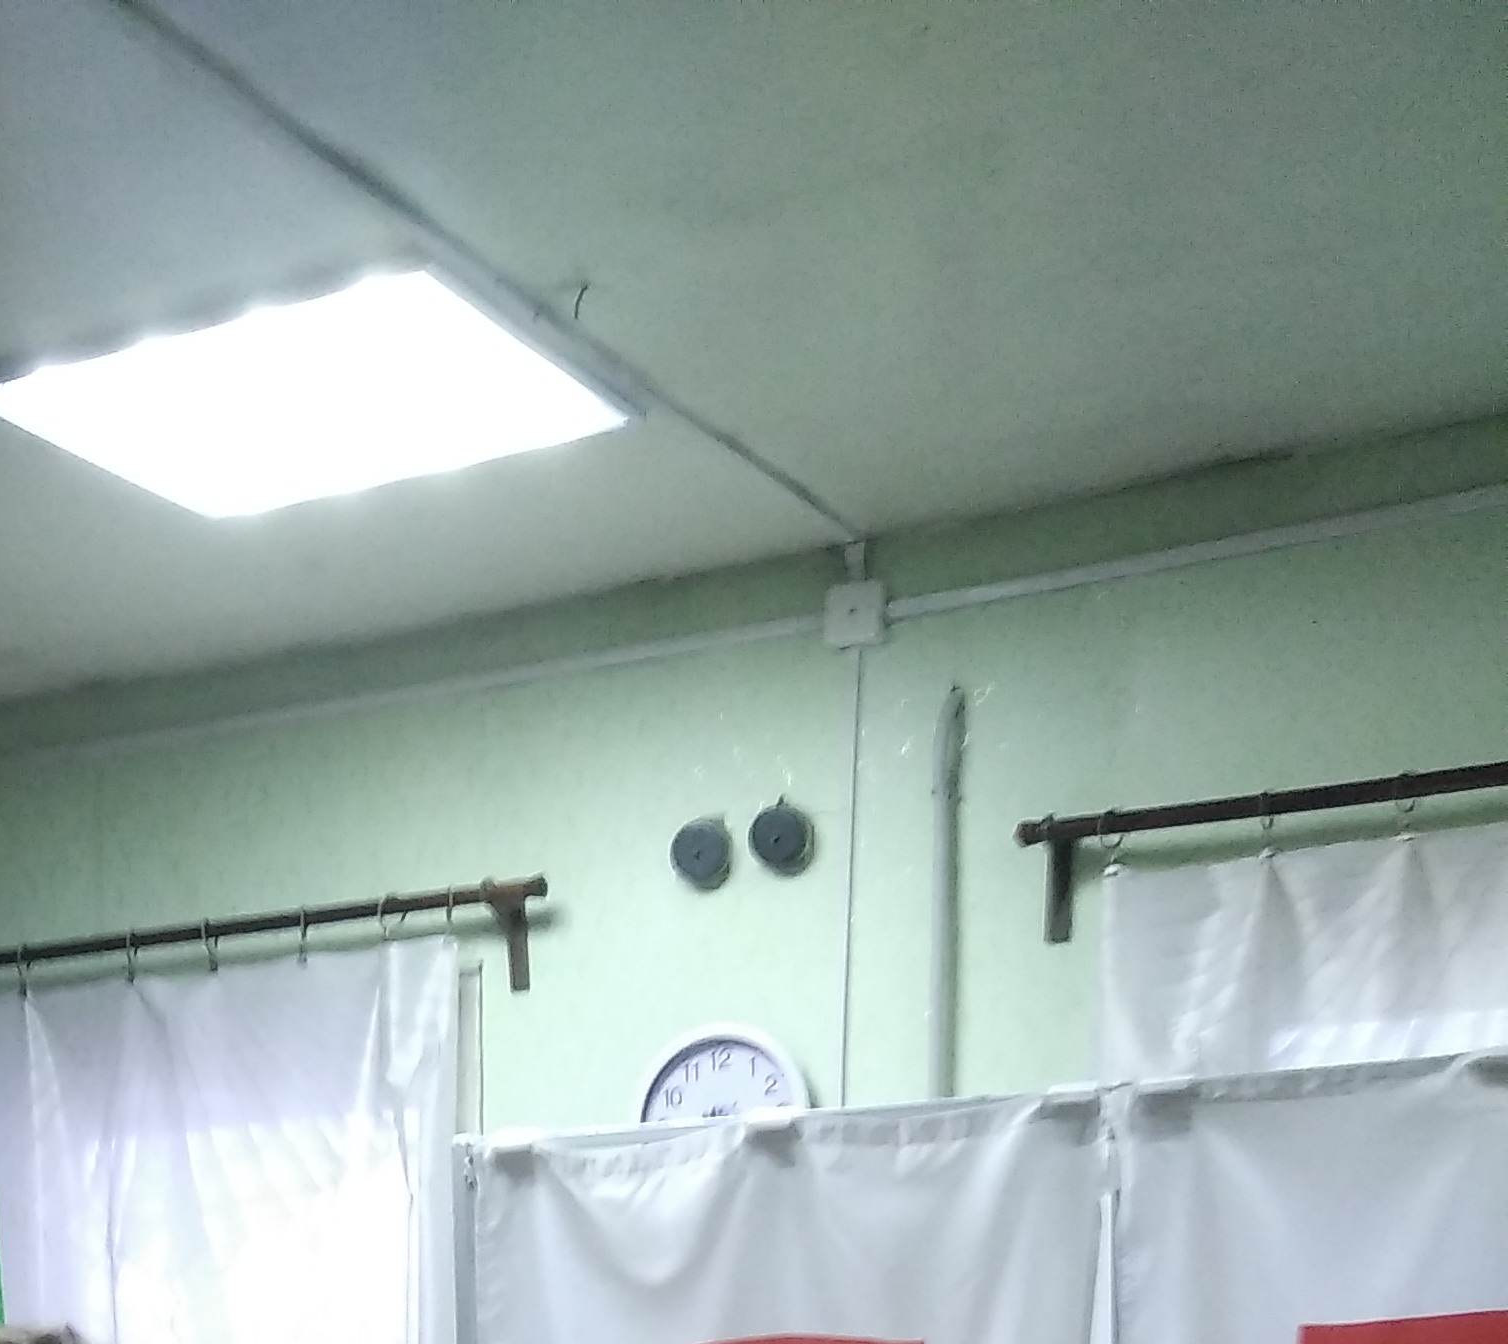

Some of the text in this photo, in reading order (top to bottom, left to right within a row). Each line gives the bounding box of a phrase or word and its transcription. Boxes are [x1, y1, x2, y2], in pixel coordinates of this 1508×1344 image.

[711, 1047, 732, 1072] 12
[749, 1056, 757, 1078] 1
[684, 1061, 700, 1084] 11
[764, 1073, 779, 1096] 2
[664, 1085, 684, 1109] 10
